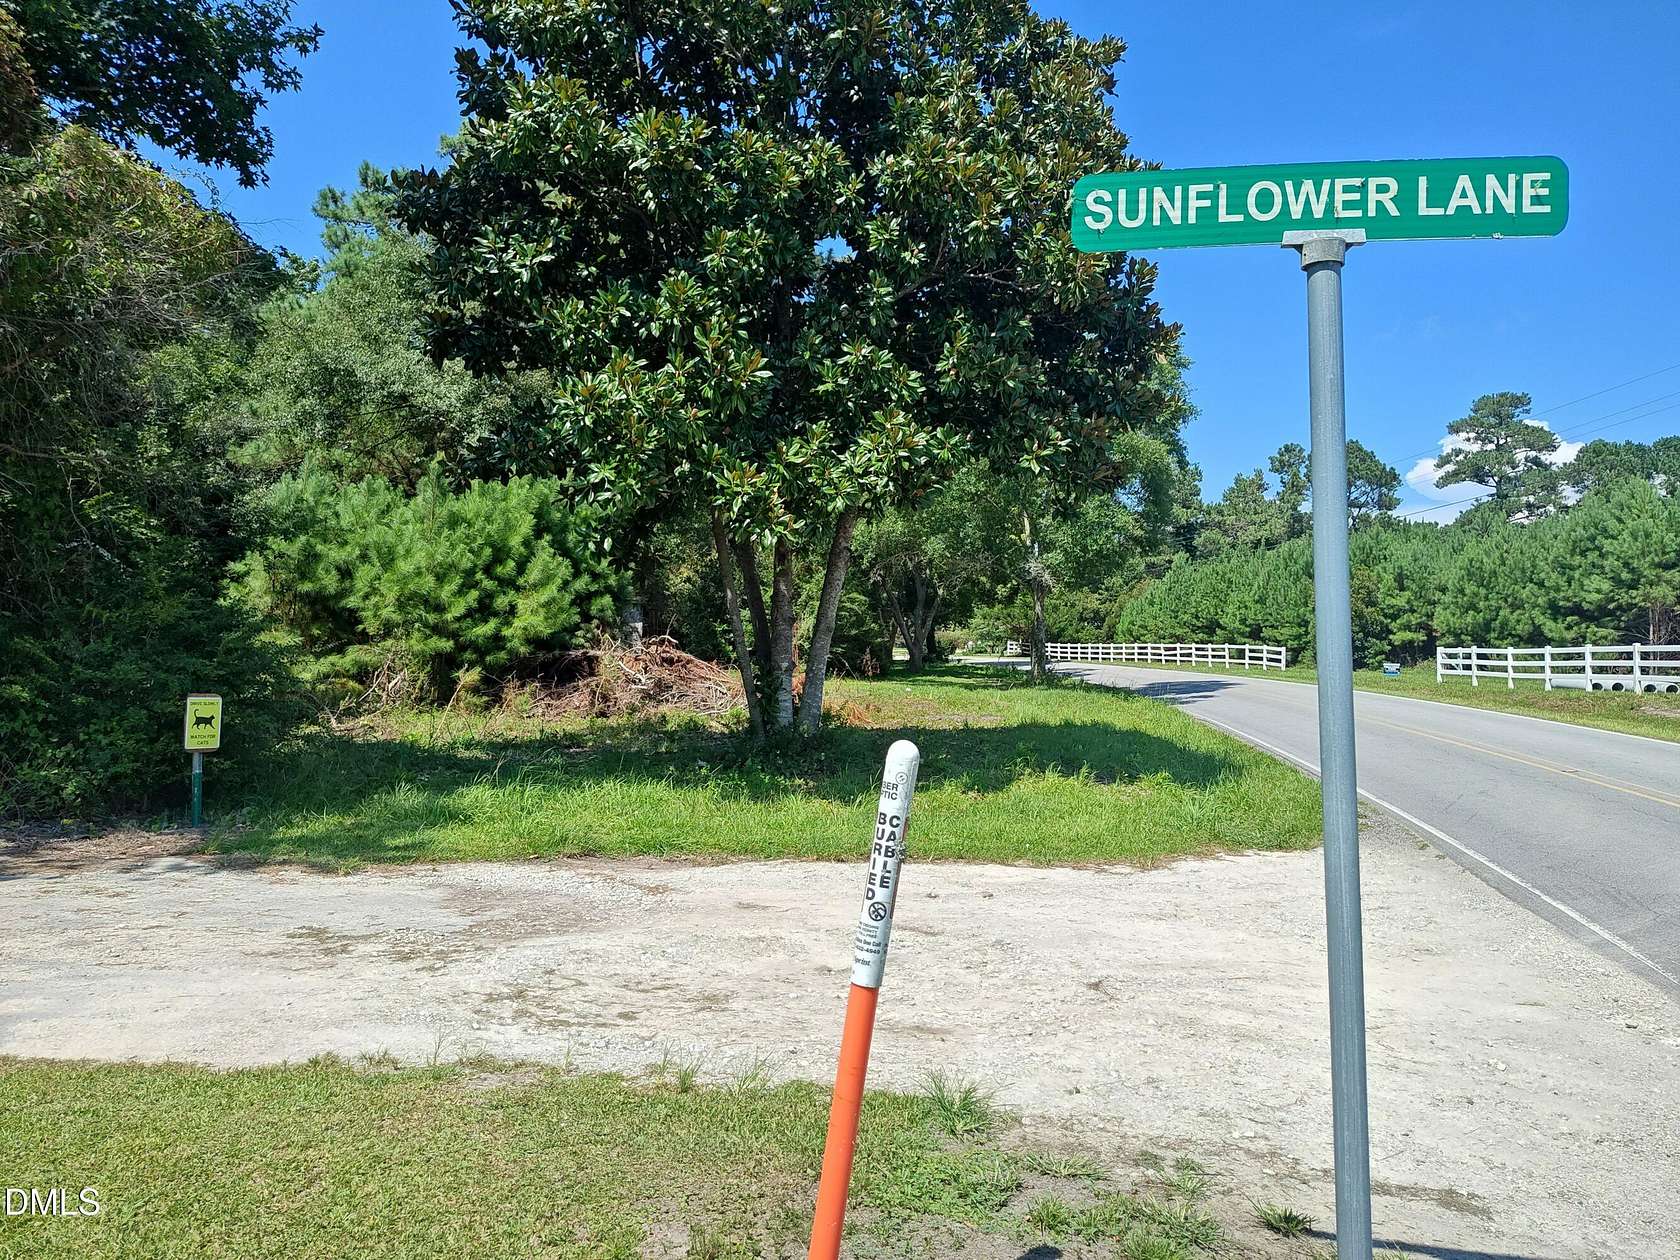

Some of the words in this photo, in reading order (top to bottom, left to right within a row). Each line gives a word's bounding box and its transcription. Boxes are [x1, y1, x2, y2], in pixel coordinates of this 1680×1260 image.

[1083, 177, 1400, 231] SUNFLOWER
[1418, 172, 1552, 217] LANE
[865, 812, 888, 901] BURIED
